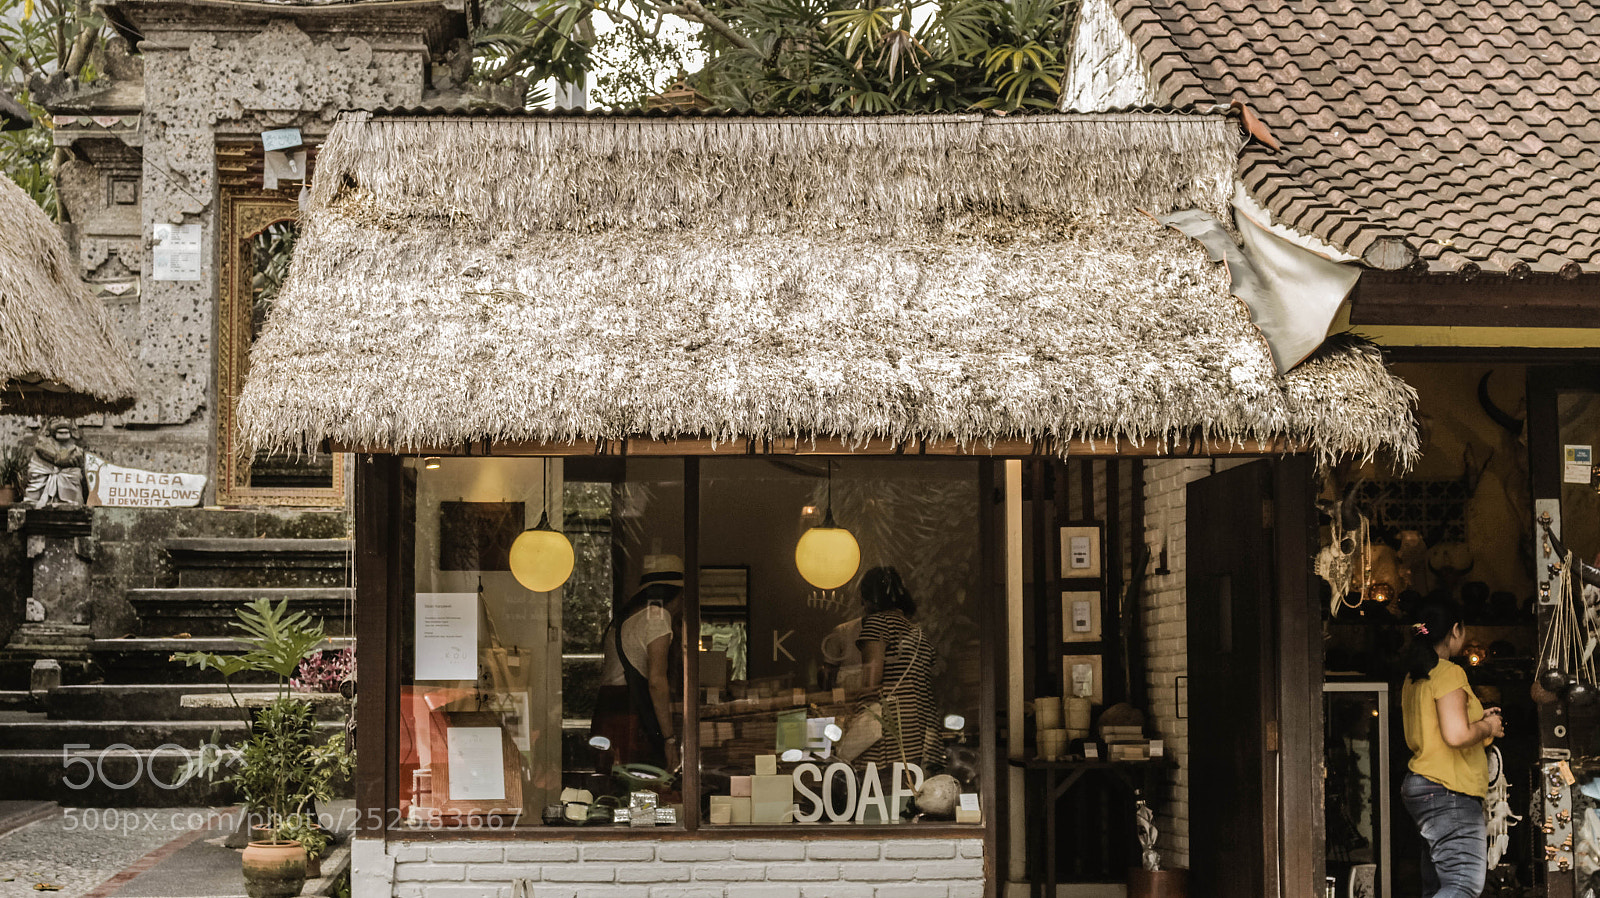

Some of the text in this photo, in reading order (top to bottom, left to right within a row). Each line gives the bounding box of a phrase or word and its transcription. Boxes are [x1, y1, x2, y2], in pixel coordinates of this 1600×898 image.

[111, 472, 184, 485] TELAGA
[109, 487, 199, 499] BUNGALOWS
[793, 762, 925, 822] SOAP
